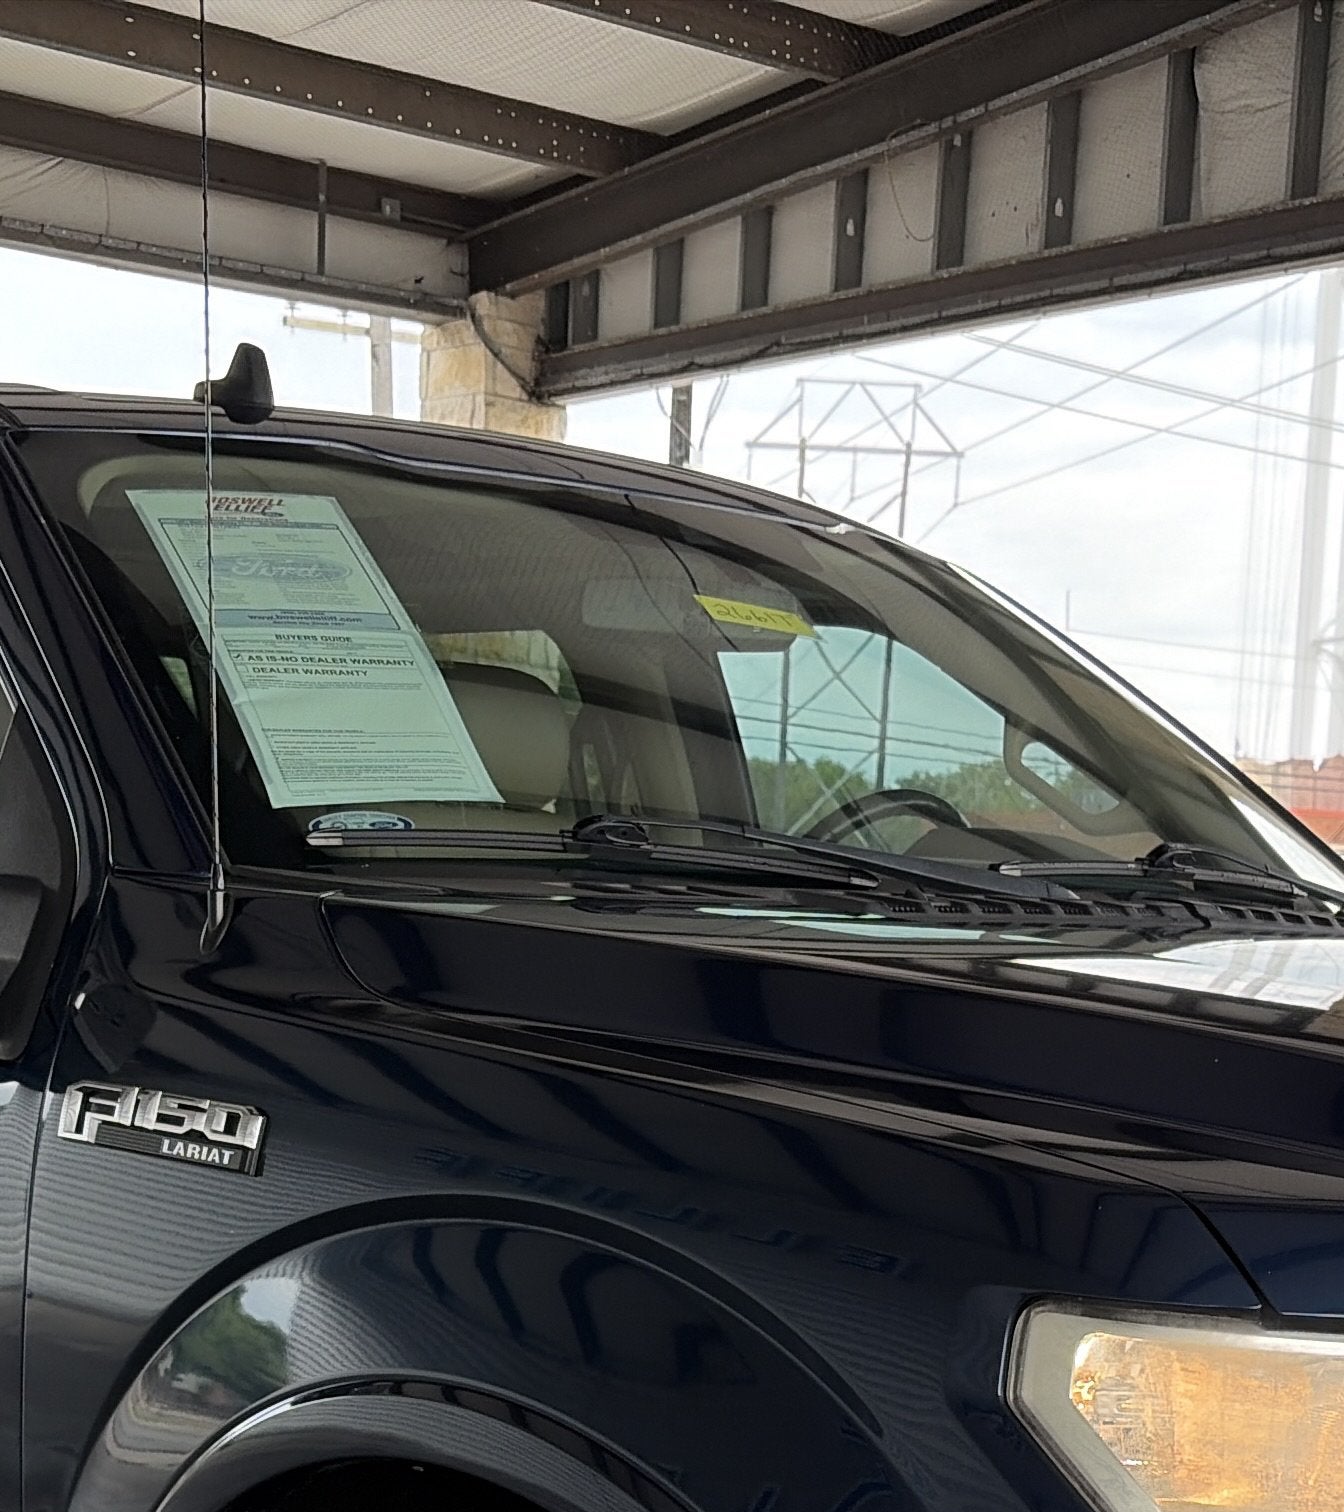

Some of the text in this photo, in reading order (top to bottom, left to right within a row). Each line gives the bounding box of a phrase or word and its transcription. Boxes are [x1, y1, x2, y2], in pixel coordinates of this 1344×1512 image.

[274, 634, 353, 643] BUYERS GUIDE
[301, 656, 348, 665] DEALER
[349, 658, 415, 667] WARRANTY
[252, 667, 368, 677] DEALER WARRANTY
[160, 1138, 235, 1166] LARIAT
